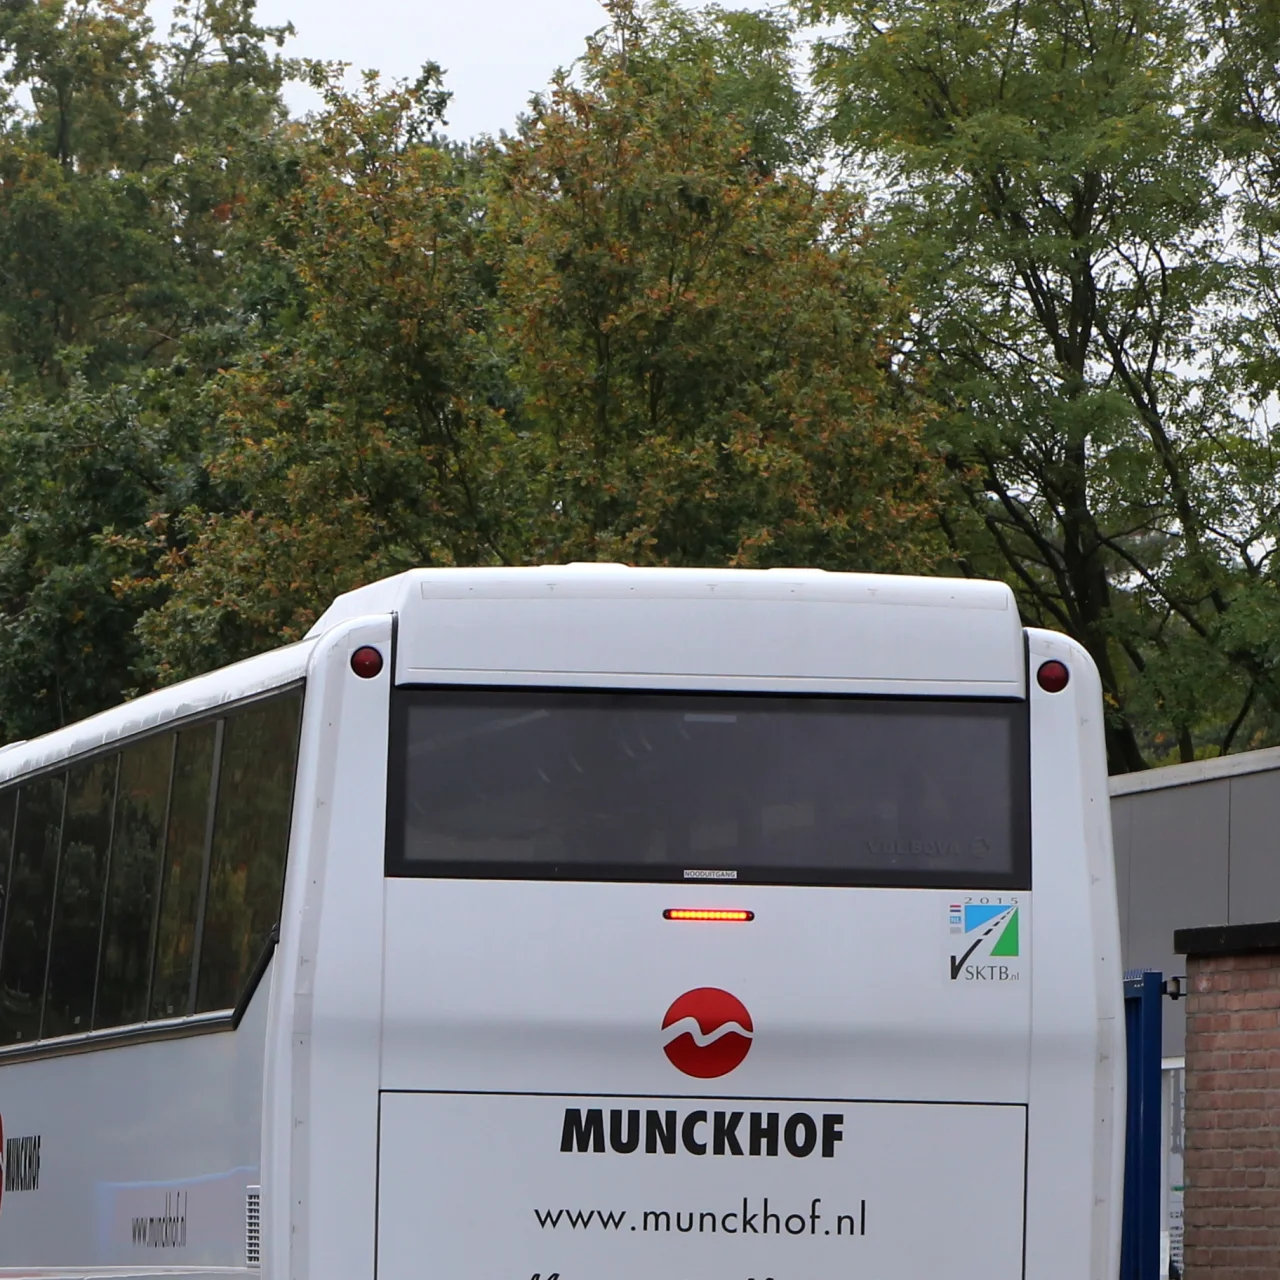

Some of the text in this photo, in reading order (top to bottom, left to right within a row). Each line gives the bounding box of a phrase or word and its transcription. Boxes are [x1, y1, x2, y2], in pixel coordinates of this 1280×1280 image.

[684, 870, 736, 879] NOODUITGANG
[964, 896, 1018, 905] 2015
[965, 965, 1019, 981] SKTB.nl
[560, 1107, 844, 1158] MUNCKHOF
[5, 1134, 41, 1192] MUNCKHOF
[533, 1196, 866, 1236] www.munckhof.nl
